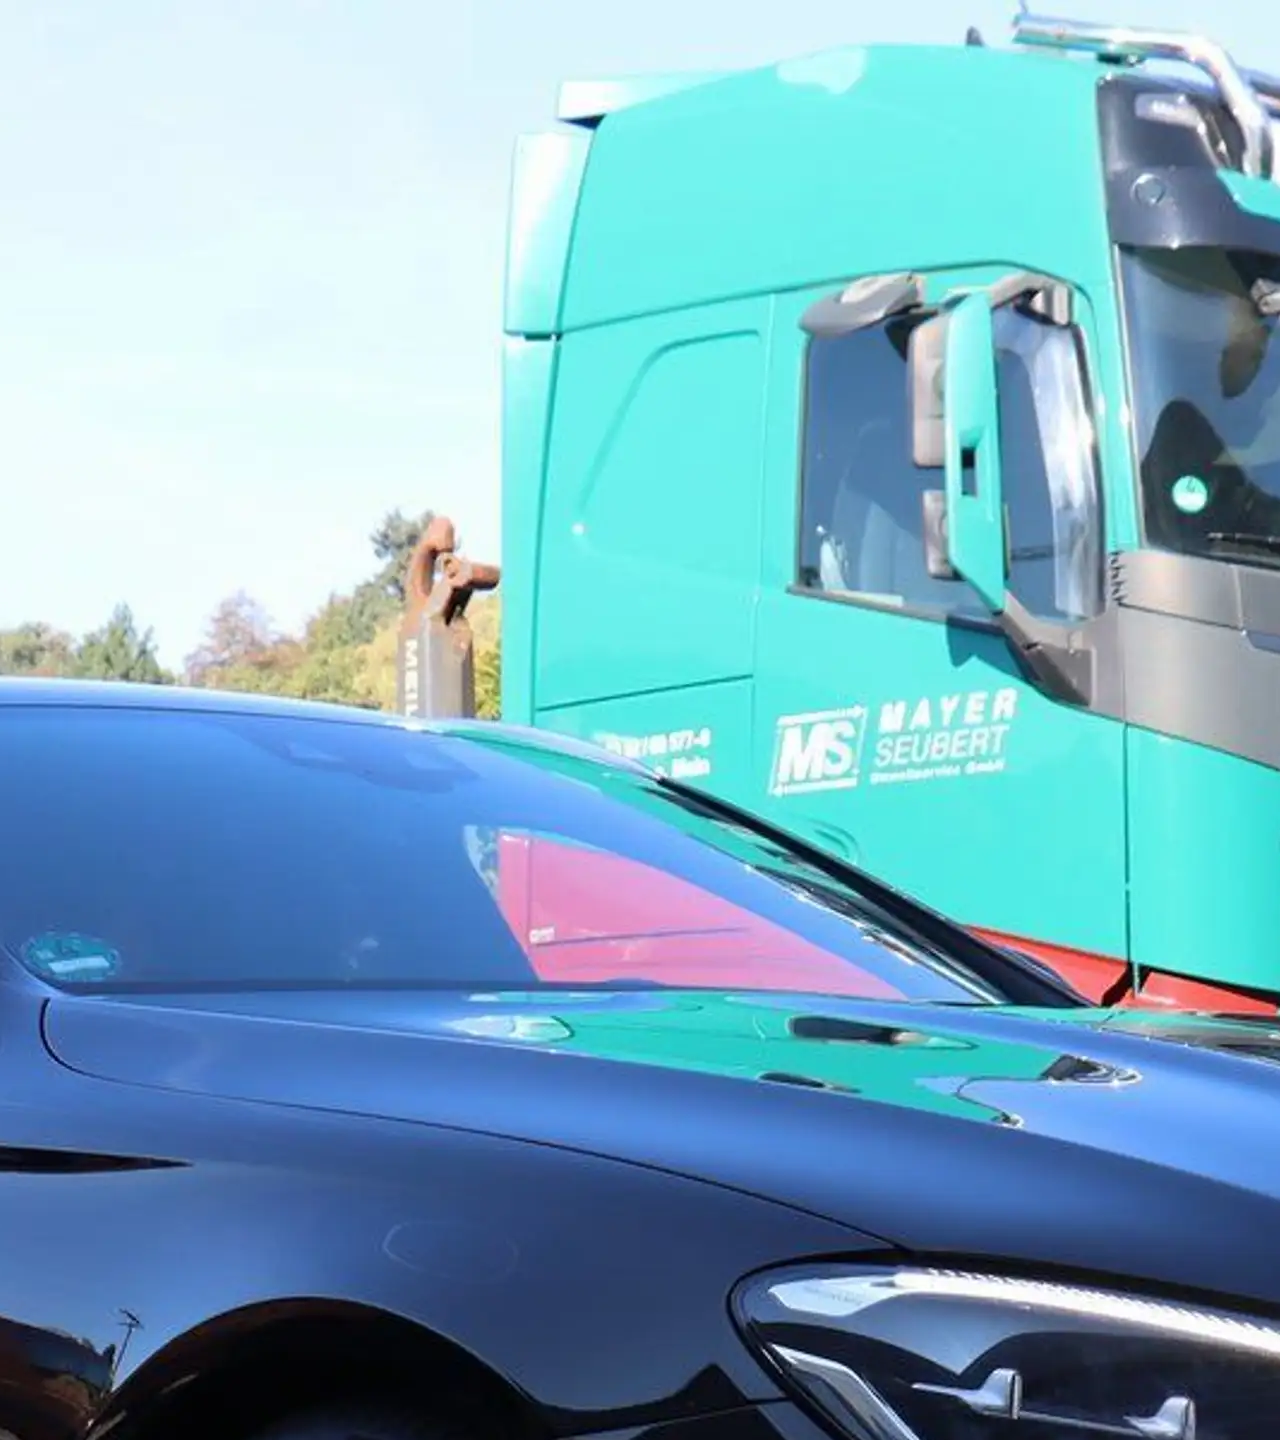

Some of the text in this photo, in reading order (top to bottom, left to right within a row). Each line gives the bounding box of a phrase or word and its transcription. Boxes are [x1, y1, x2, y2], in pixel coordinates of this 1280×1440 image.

[877, 687, 1018, 733] MAYER
[777, 719, 858, 783] MS
[873, 723, 1011, 768] SEUBERT
